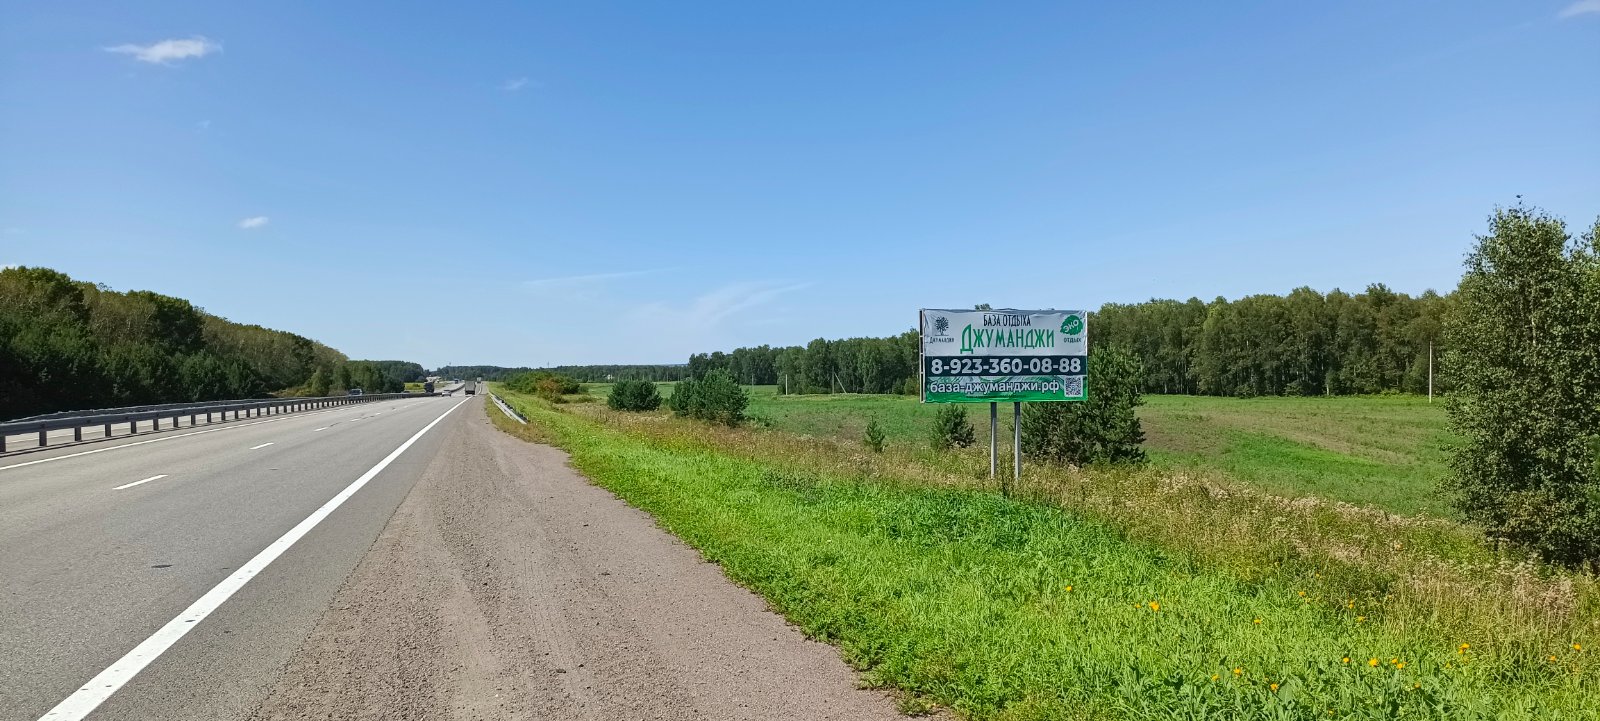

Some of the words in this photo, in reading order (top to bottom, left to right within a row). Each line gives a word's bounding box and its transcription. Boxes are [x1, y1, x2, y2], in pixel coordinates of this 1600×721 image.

[984, 315, 1000, 326] БАЗА
[1003, 315, 1031, 326] ОТДЫХА
[931, 358, 1081, 374] 8-923-360-08-88
[930, 380, 1059, 394] база-джуманджи.рф
